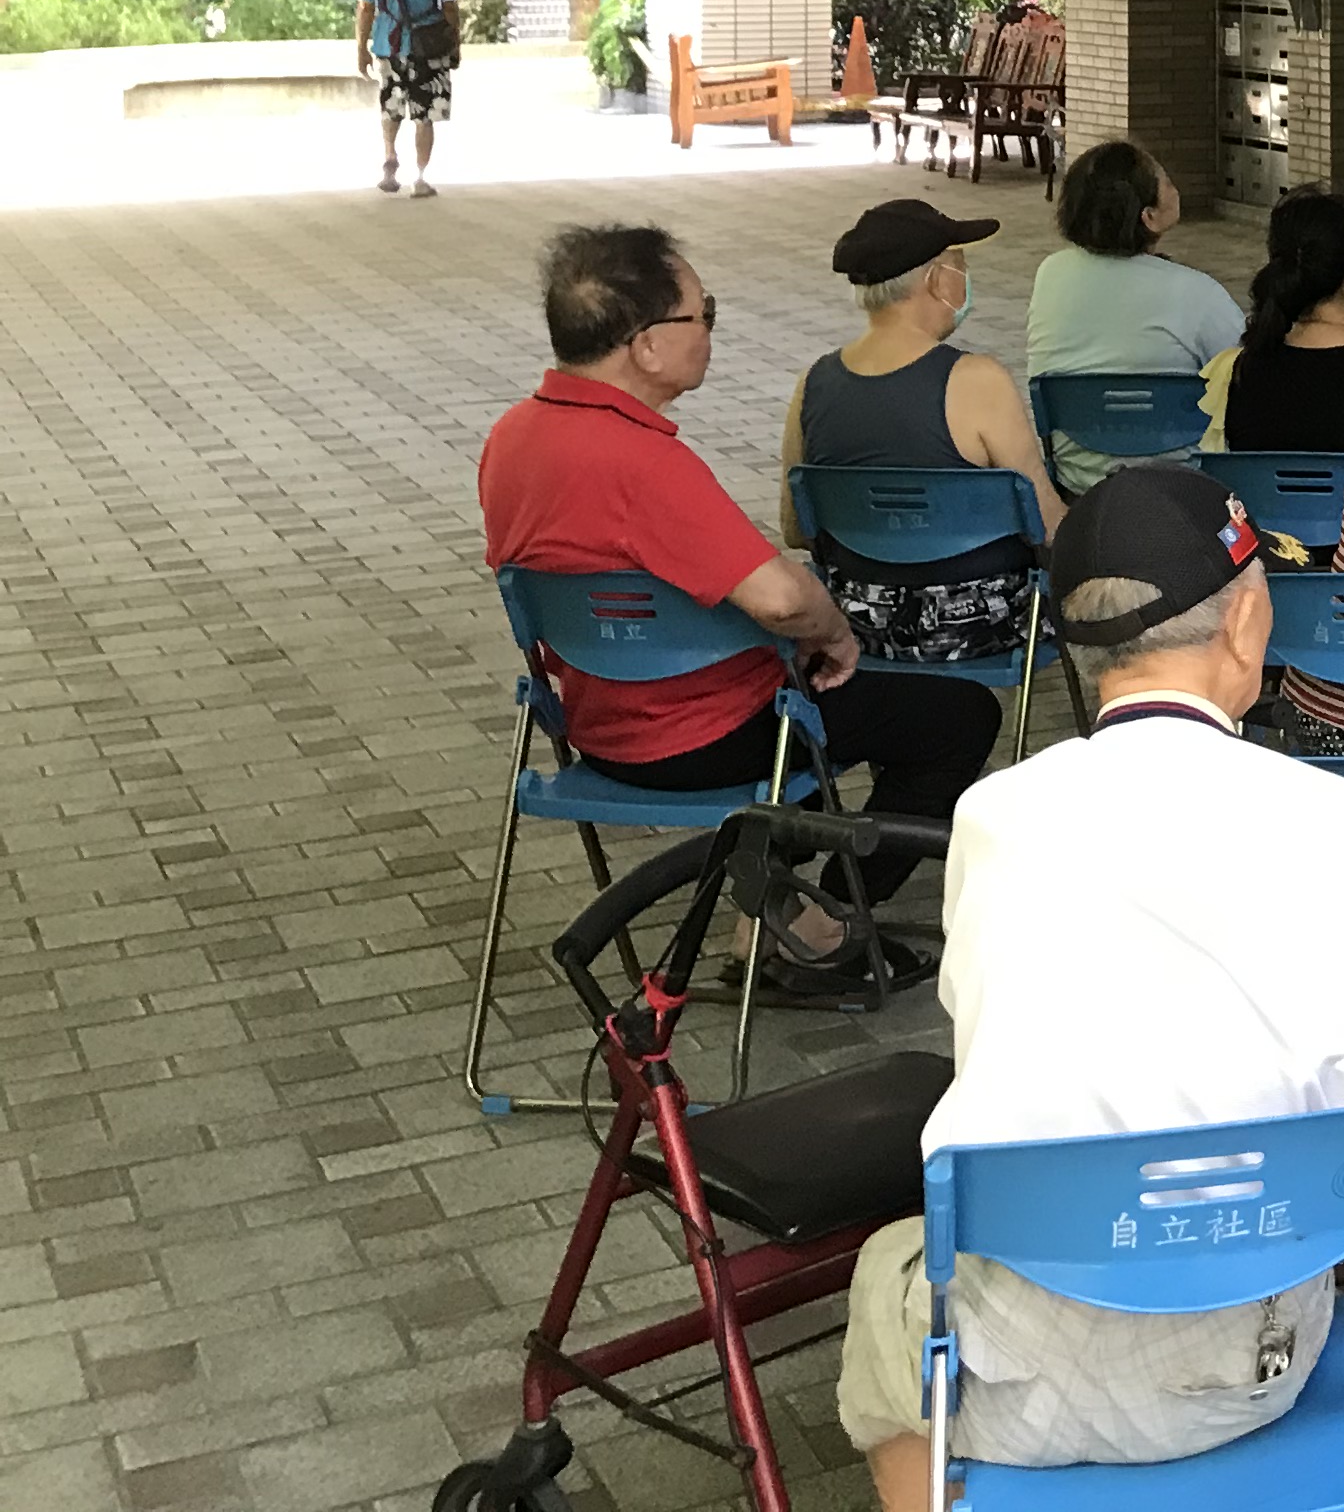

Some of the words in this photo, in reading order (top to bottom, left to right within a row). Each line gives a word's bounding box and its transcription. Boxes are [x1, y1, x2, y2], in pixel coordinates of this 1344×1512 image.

[600, 622, 648, 640] 自立
[1111, 1200, 1294, 1249] 自立社區
